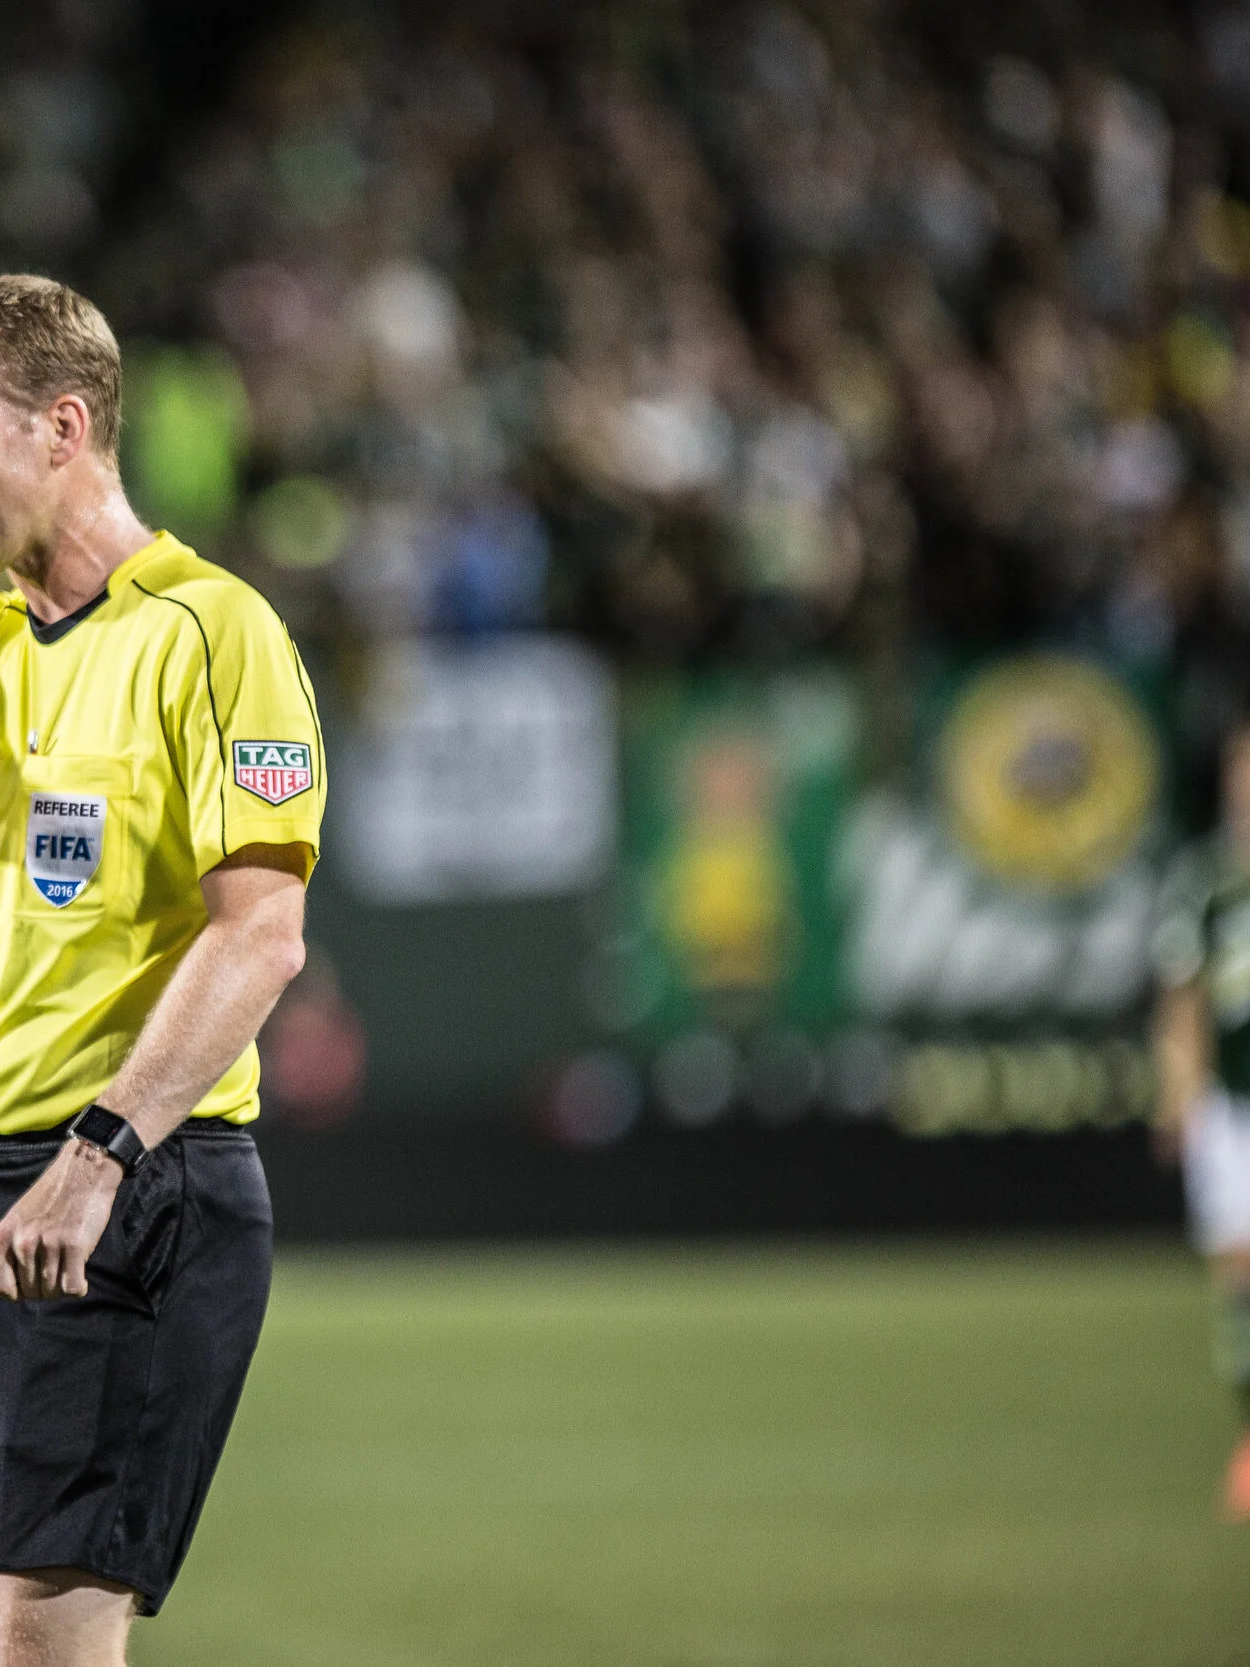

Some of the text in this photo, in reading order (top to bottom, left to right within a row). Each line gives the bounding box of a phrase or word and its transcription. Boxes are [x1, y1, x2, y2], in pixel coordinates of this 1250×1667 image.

[241, 747, 304, 766] TAG
[241, 769, 307, 798] HEUER
[34, 800, 100, 818] REFEREE
[35, 834, 92, 861] FIFA
[47, 884, 73, 897] 2016
